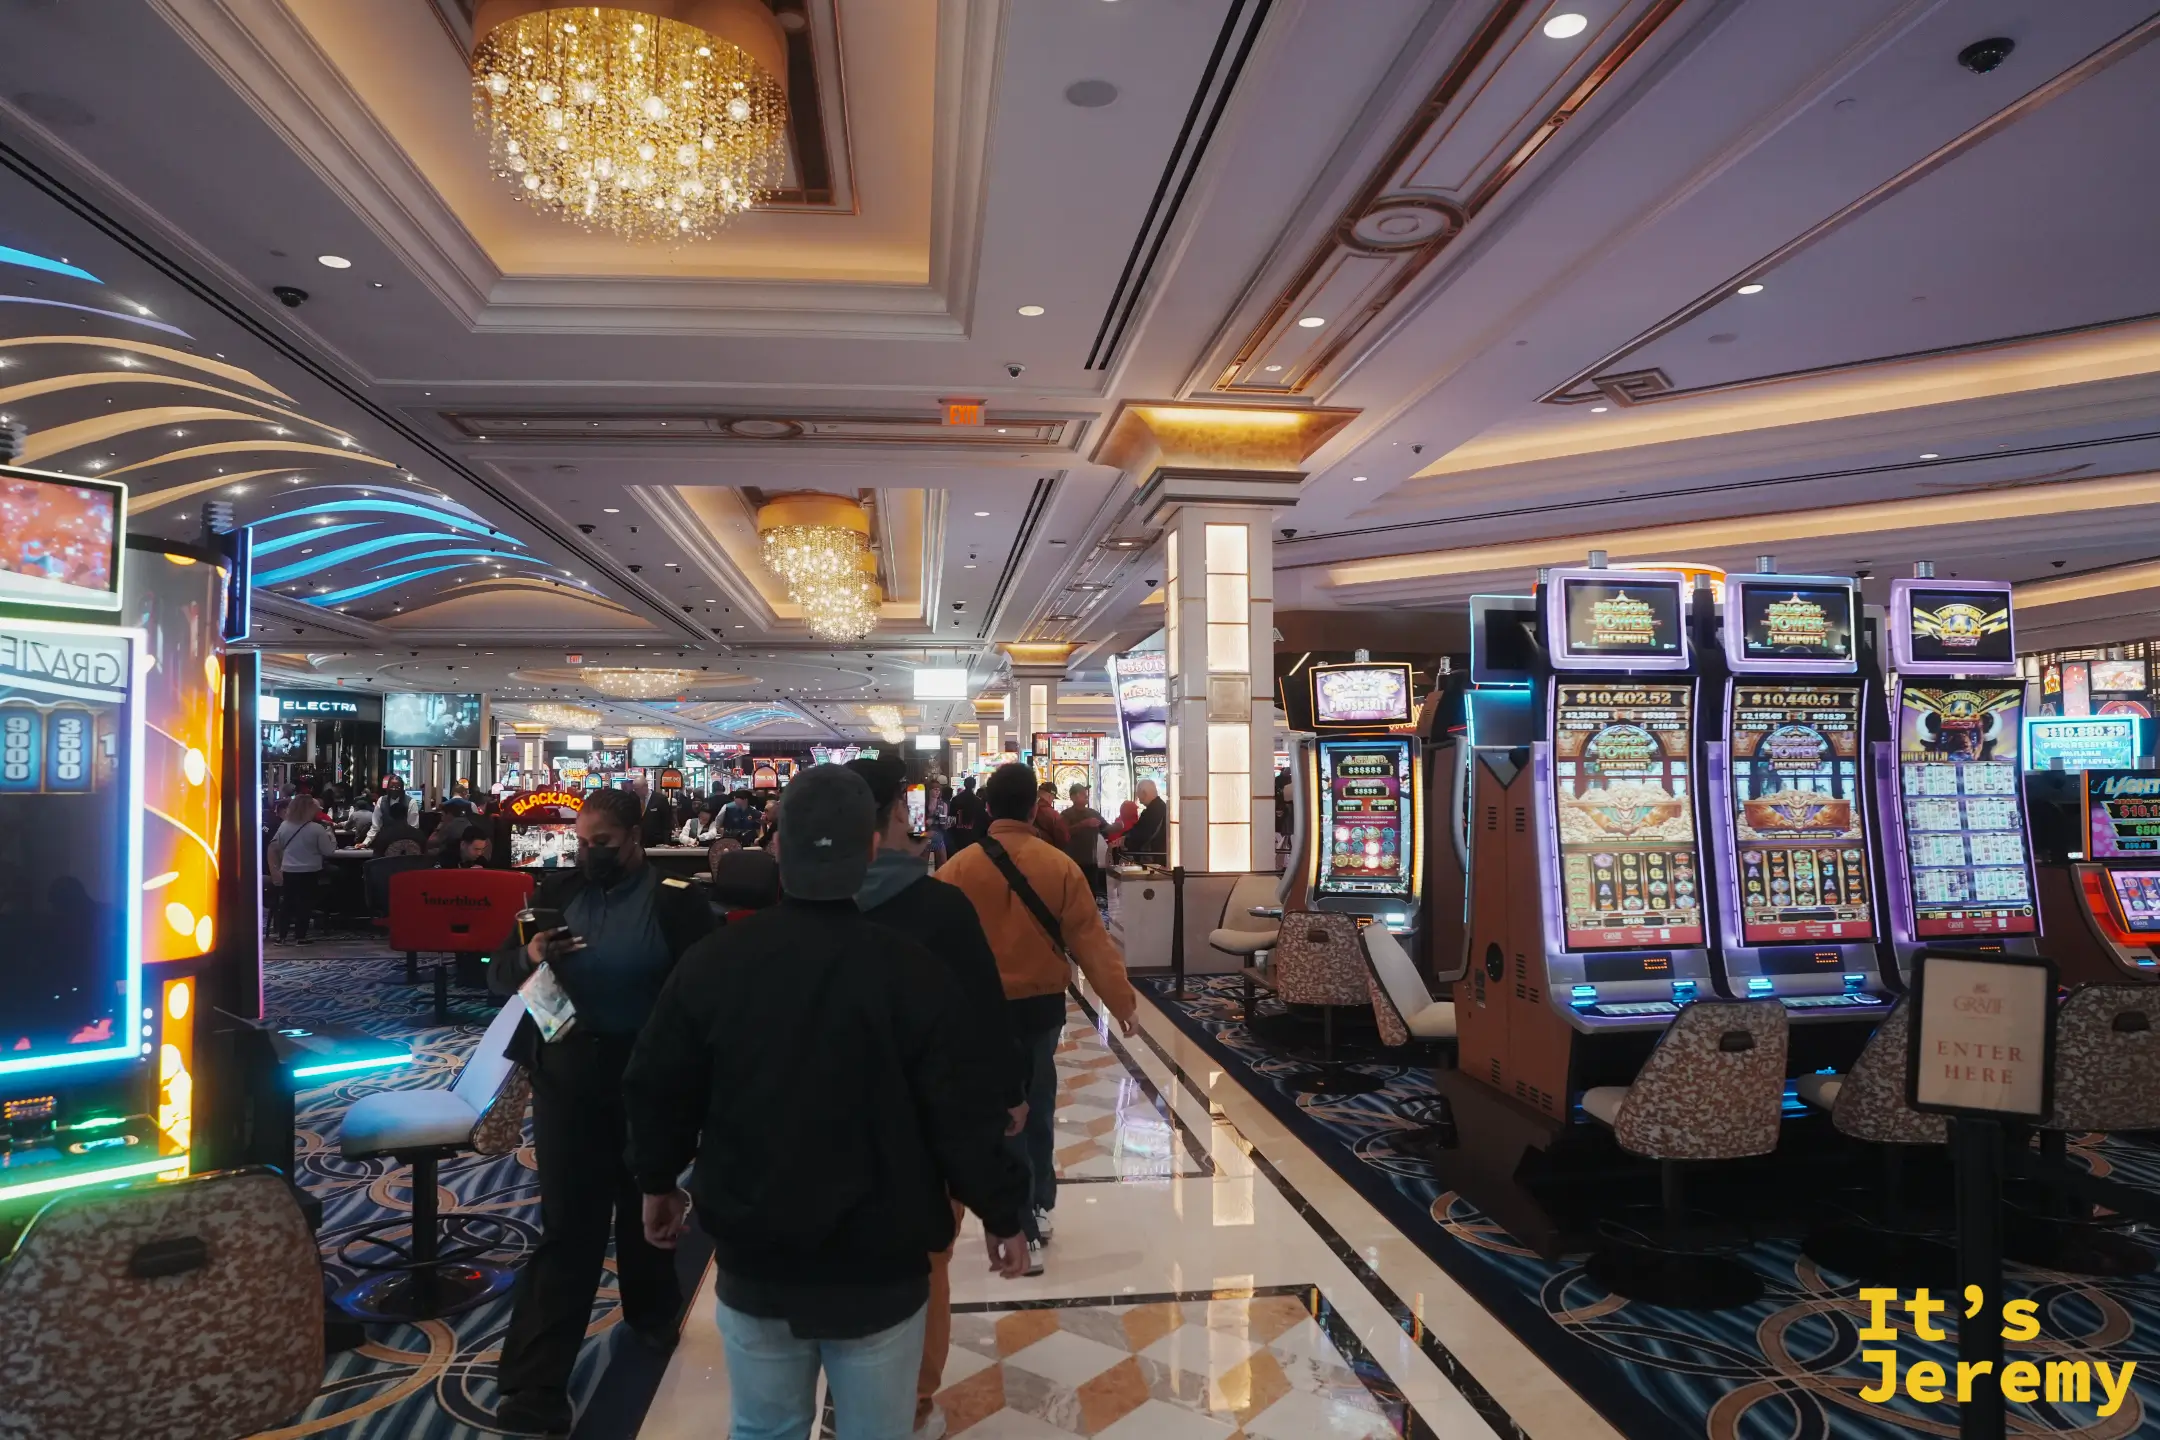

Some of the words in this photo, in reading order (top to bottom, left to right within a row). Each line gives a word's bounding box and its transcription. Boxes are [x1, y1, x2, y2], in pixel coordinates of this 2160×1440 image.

[950, 405, 977, 424] EXIT
[1769, 604, 1821, 616] DRAGON
[1594, 613, 1653, 630] TOWER
[1768, 616, 1824, 631] TOWER
[1599, 633, 1649, 643] JACKPOTS
[1774, 635, 1821, 644] JACKPOTS
[1576, 691, 1671, 706] $10,402.52
[1752, 693, 1840, 706] $10,440.61
[1940, 692, 1981, 706] WONDER
[283, 701, 357, 712] ELECTRA
[1329, 699, 1396, 713] PROSPERITY
[58, 718, 82, 780] 3500
[1599, 746, 1651, 759] TOWER
[1772, 746, 1821, 759] TOWER
[1775, 761, 1816, 769] JACKPOTS
[2120, 805, 2160, 818] $10,1
[421, 891, 491, 907] interblock
[1936, 1040, 2024, 1062] ENTER
[1944, 1064, 2013, 1085] HERE
